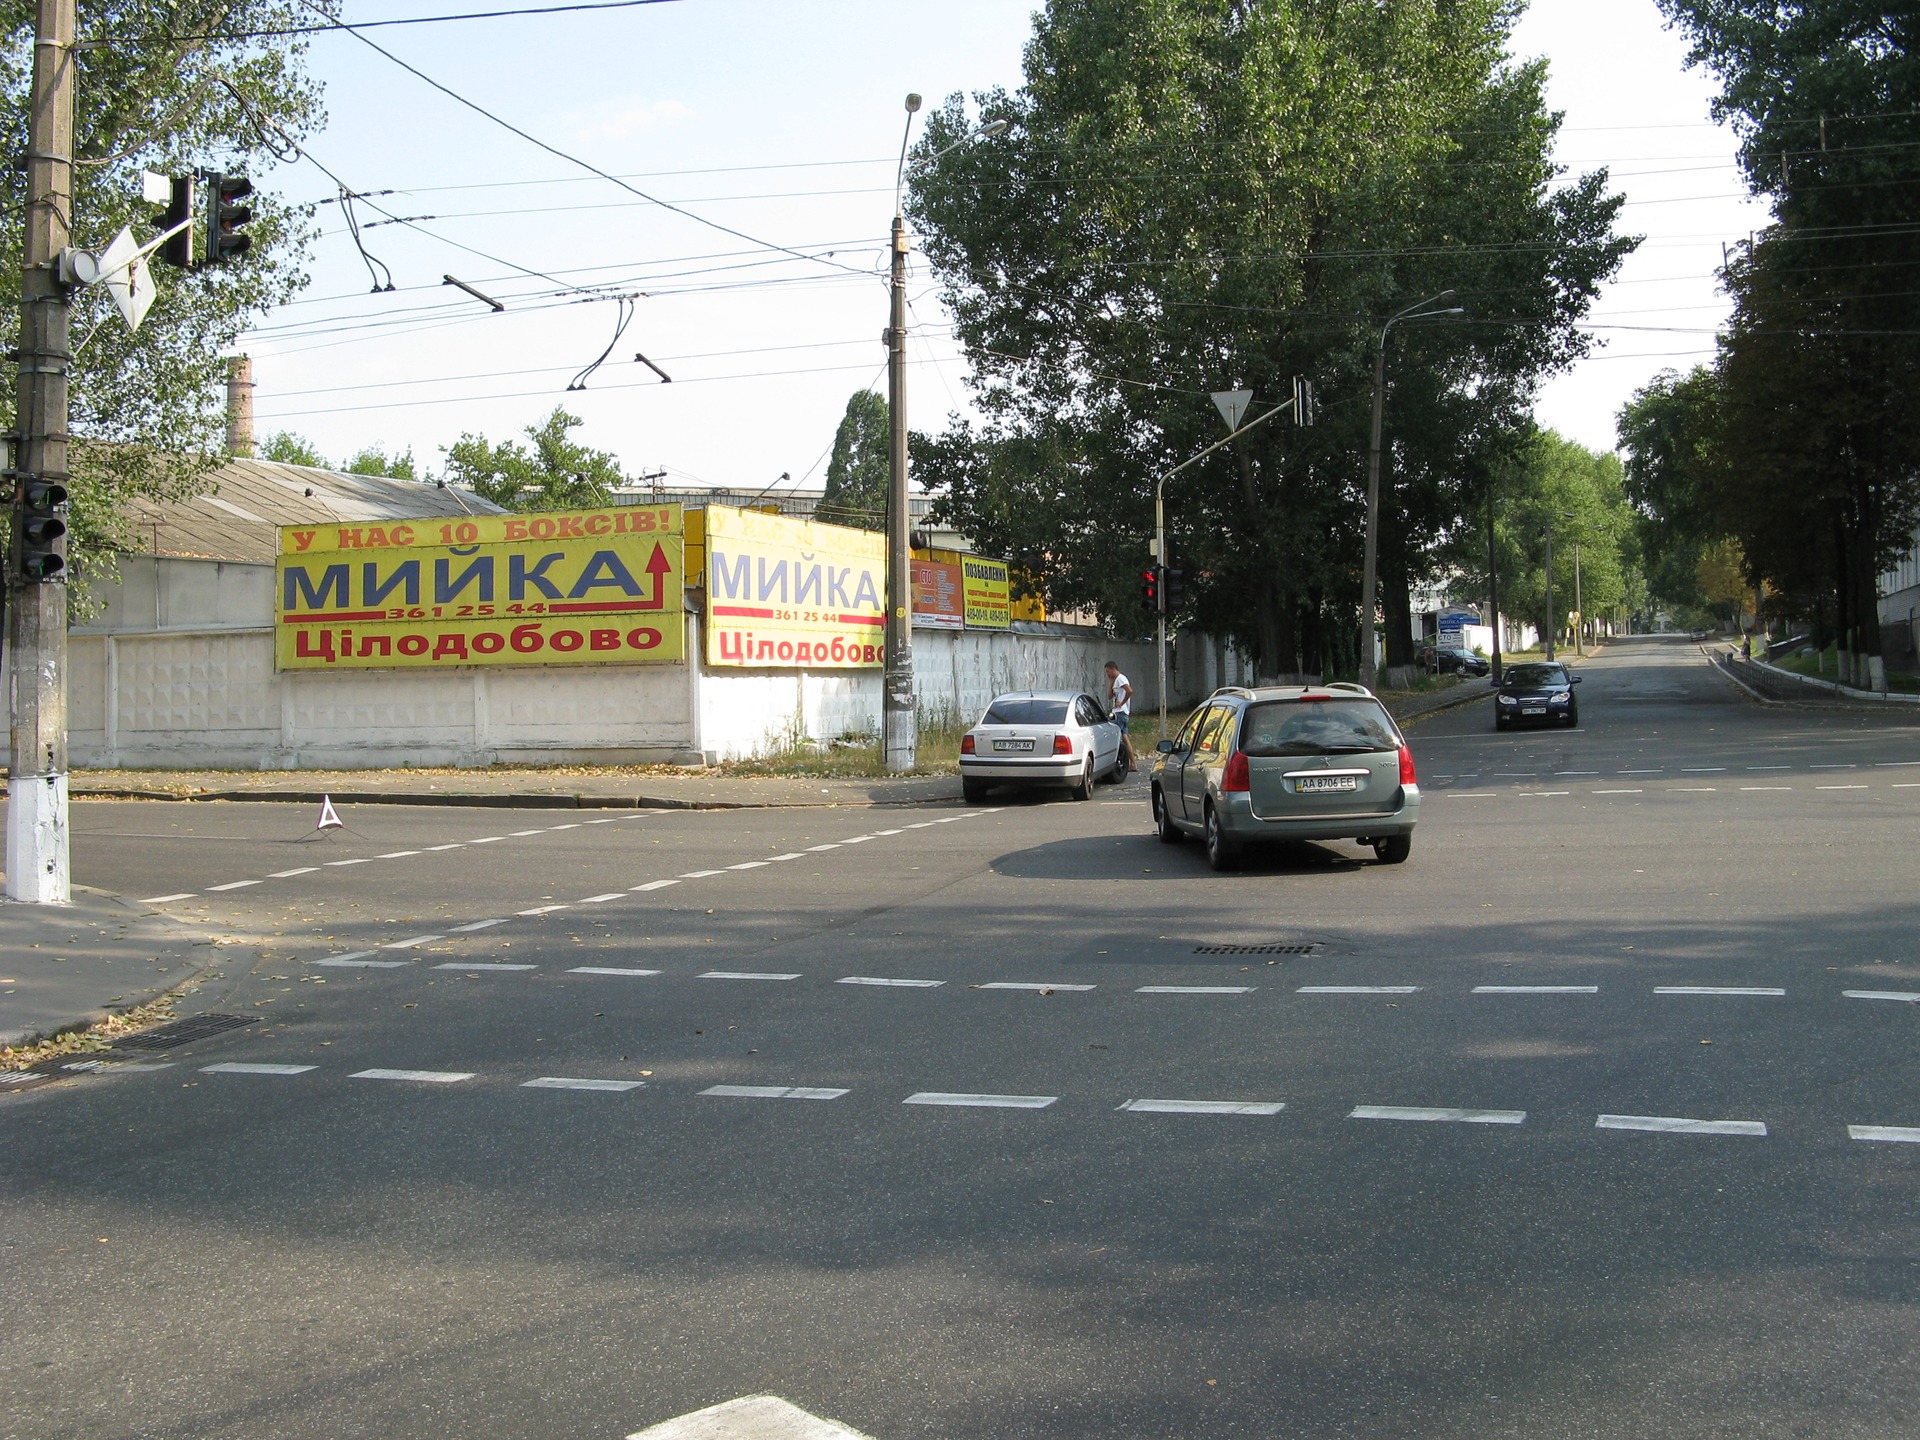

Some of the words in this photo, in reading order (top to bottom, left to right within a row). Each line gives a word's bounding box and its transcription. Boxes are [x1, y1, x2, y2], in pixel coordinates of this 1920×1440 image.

[291, 531, 316, 551] У
[338, 525, 415, 548] НАС
[440, 522, 479, 544] 10
[504, 509, 671, 541] БОКСІВ!
[283, 544, 645, 611] МИЙКА
[711, 551, 881, 611] МИЙКА
[387, 606, 443, 620] 361
[458, 605, 496, 617] 25
[506, 602, 547, 615] 44
[775, 609, 799, 621] 361
[803, 611, 818, 622] 25
[822, 613, 837, 623] 44
[295, 623, 663, 663] Цілодобово
[1302, 779, 1316, 788] AA
[1317, 778, 1338, 788] 8706
[1341, 777, 1353, 787] EE
